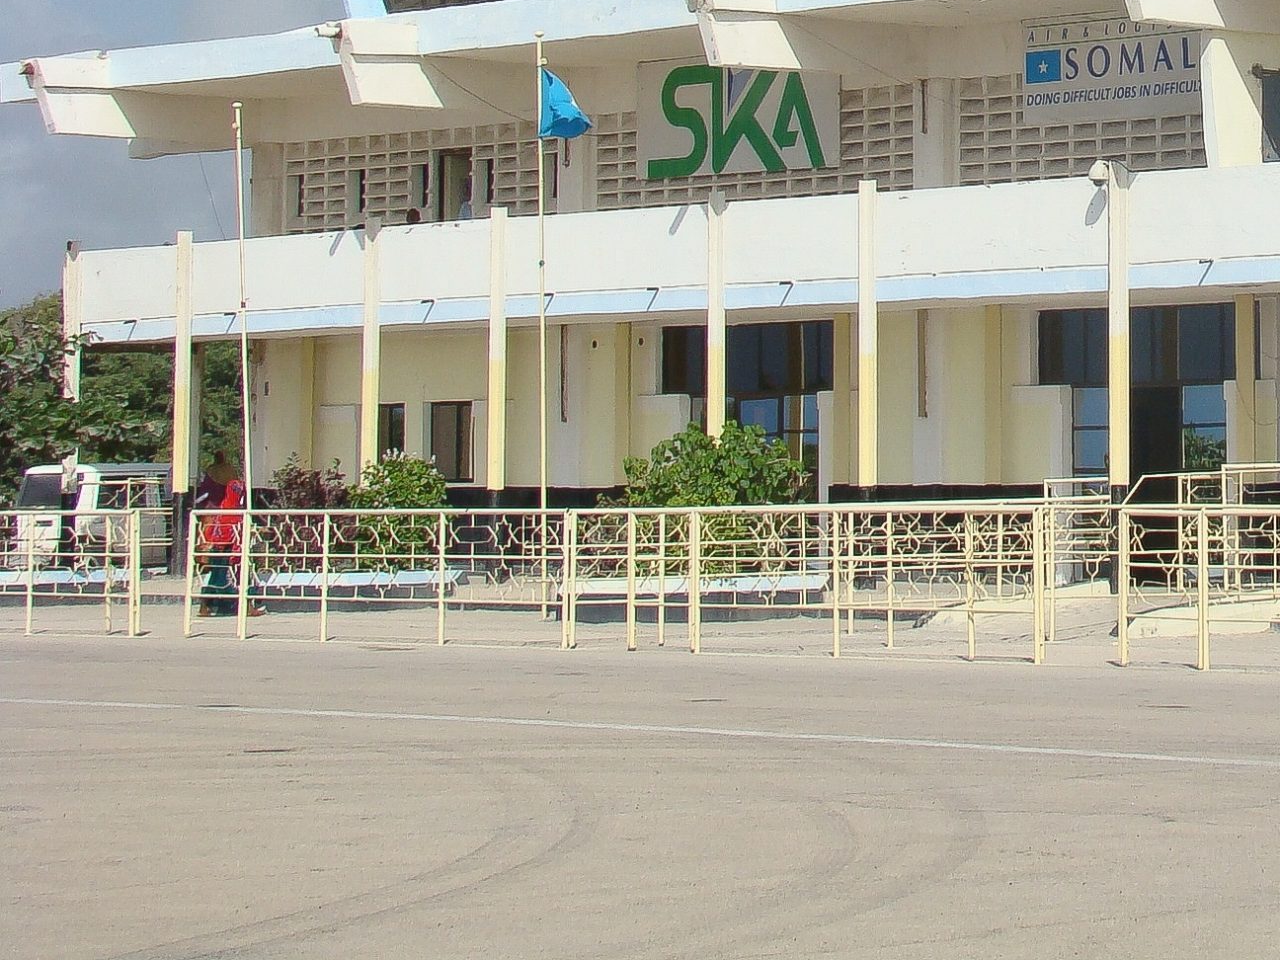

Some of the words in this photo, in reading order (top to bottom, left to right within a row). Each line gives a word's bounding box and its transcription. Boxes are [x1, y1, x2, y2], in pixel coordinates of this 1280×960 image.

[1028, 28, 1068, 42] AIR
[1105, 22, 1172, 35] LOGI
[1027, 92, 1060, 106] DOING
[1063, 87, 1111, 103] DIFFICULT
[1112, 86, 1137, 100] JOBS
[1140, 84, 1151, 97] IN
[648, 64, 826, 179] SKA
